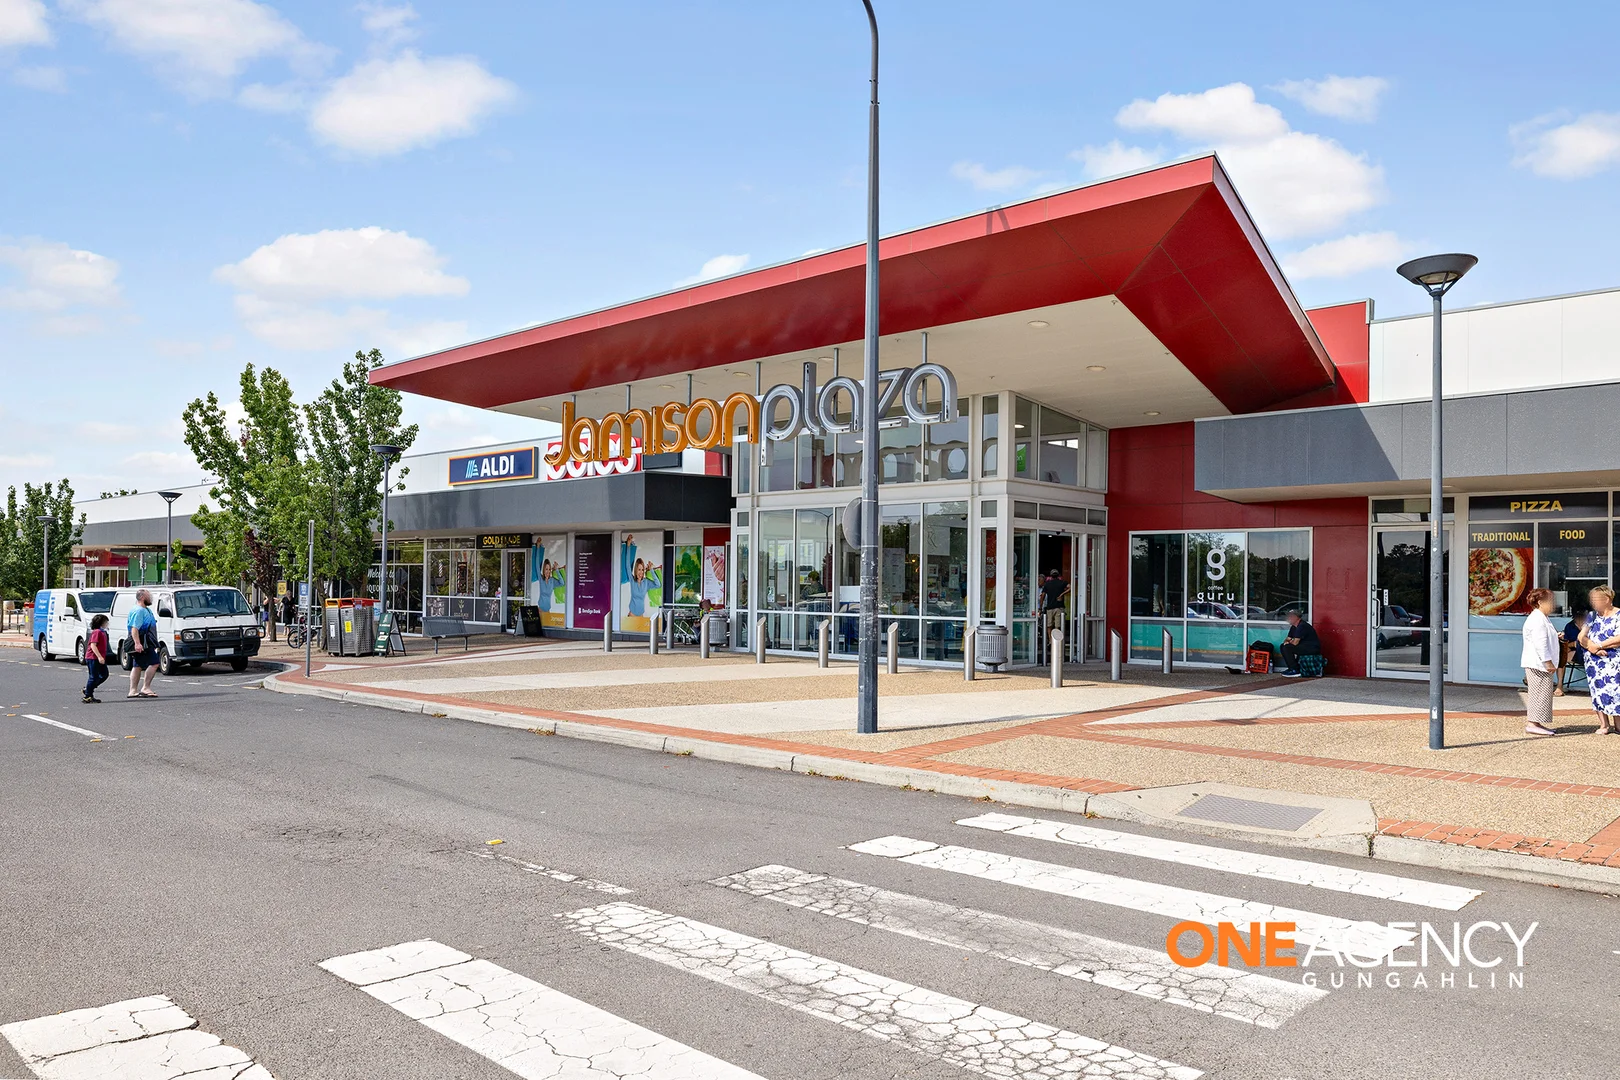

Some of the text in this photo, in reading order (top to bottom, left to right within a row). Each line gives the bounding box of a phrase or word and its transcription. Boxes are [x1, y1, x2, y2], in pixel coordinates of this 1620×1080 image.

[480, 455, 515, 477] ALDI
[1510, 500, 1563, 513] PIZZA
[482, 536, 500, 545] GOLD
[1472, 530, 1585, 542] TRADITIONAL FOOD
[1206, 547, 1226, 581] g
[1197, 592, 1235, 604] guru
